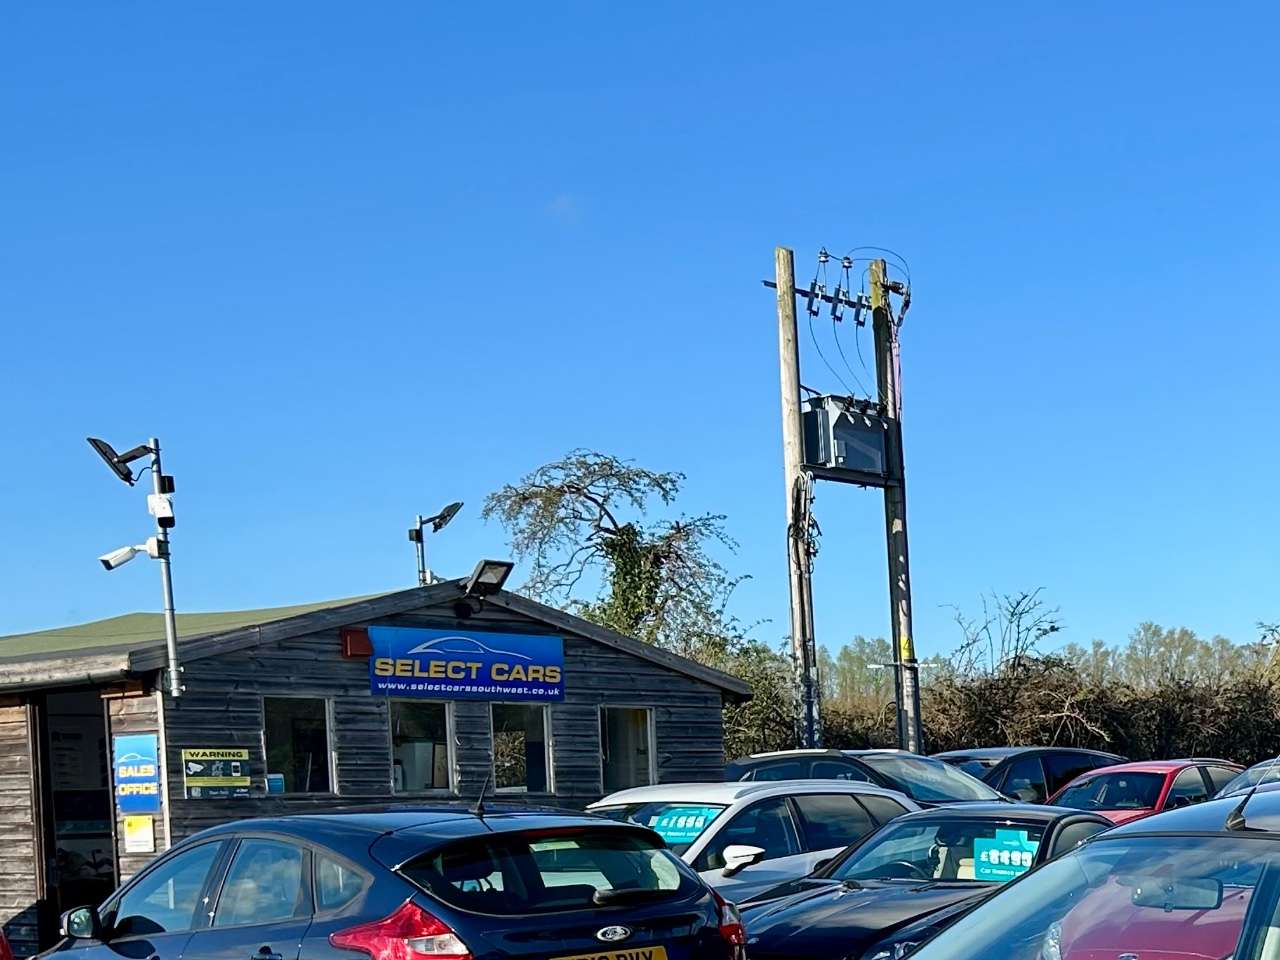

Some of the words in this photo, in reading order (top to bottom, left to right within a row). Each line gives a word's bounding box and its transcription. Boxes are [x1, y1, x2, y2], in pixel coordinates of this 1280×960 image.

[374, 657, 483, 680] SELECT
[490, 662, 562, 683] CARS
[377, 681, 561, 696] www.selectcarssouthwest.co.uk
[118, 764, 155, 777] SALES
[118, 782, 157, 795] OFFICE
